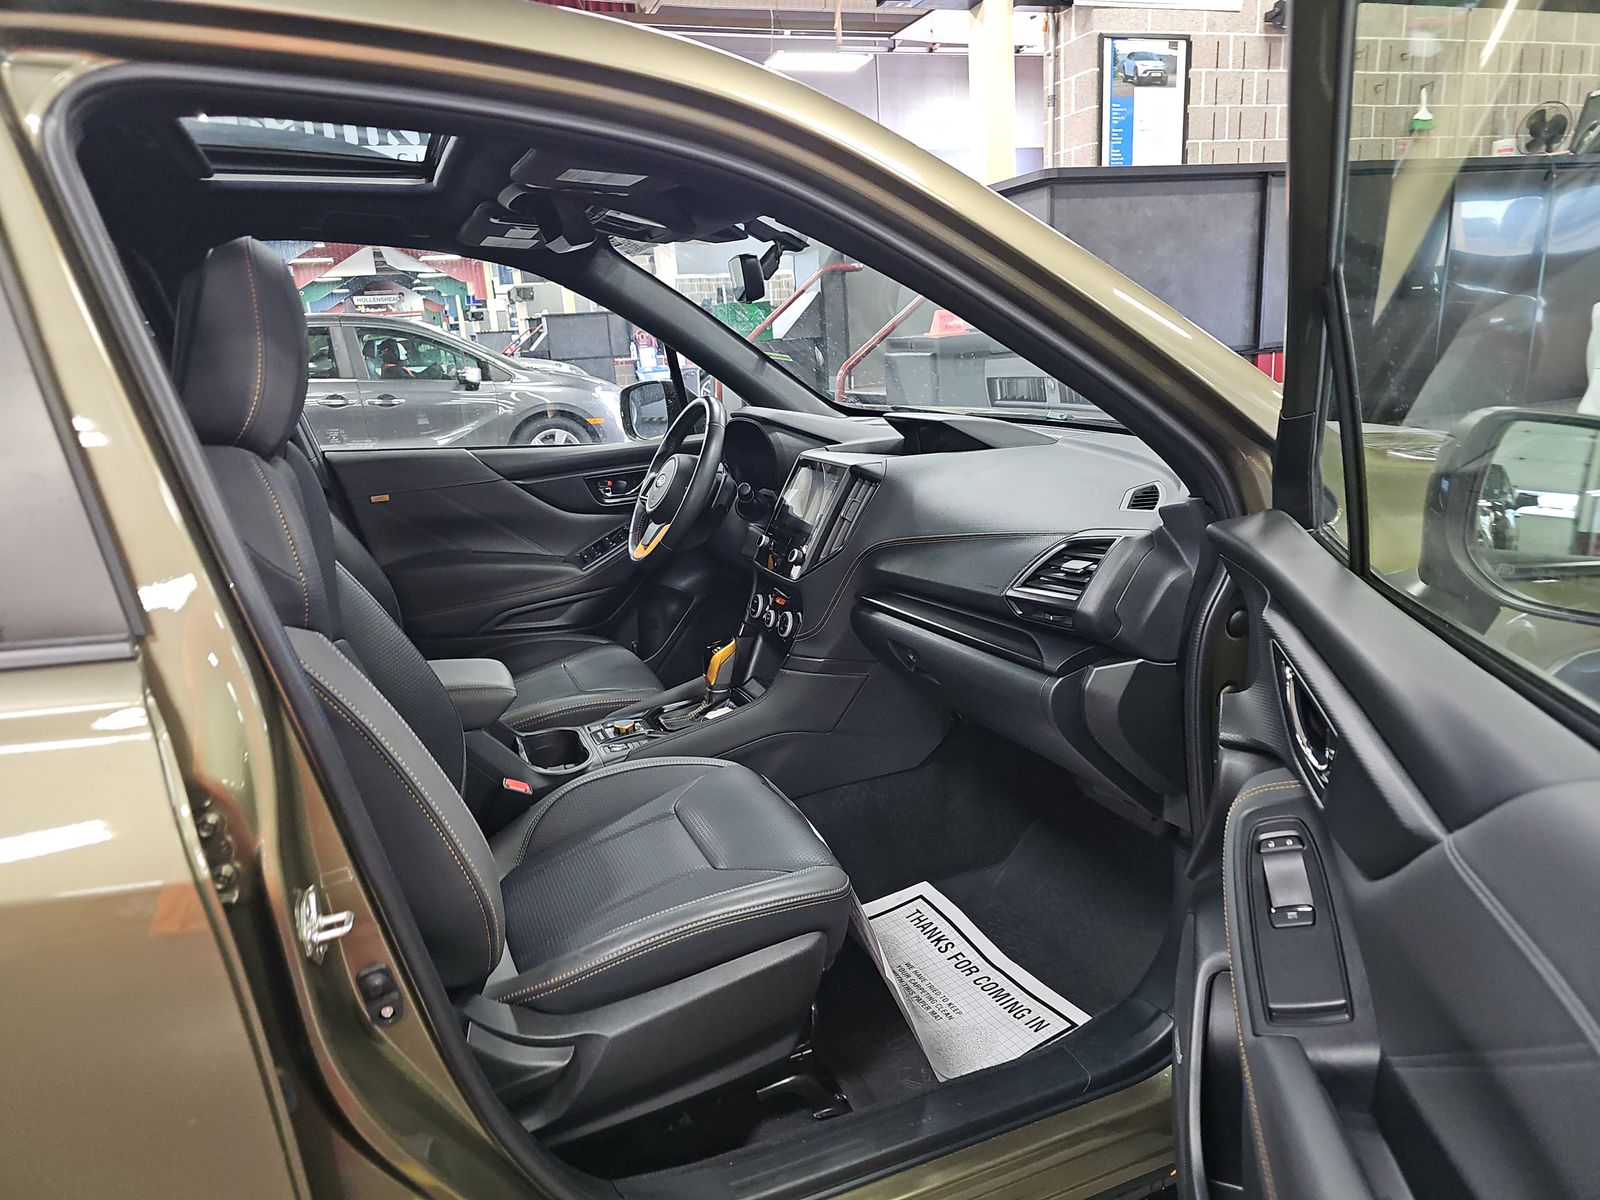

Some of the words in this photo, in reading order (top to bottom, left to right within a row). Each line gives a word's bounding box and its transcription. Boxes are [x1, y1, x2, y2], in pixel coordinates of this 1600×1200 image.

[896, 964, 911, 979] YOUR
[908, 978, 938, 1005] CARPETING
[935, 1003, 955, 1021] CLEAN
[905, 962, 916, 970] WE
[912, 970, 928, 983] HAVE
[925, 982, 942, 997] TRIED
[940, 995, 950, 1003] TO
[947, 1002, 963, 1015] KEEP
[906, 908, 955, 954] THANKS
[947, 952, 980, 977] FOR
[973, 976, 1032, 1021] COMING
[1024, 1016, 1051, 1033] IN
[901, 982, 916, 996] THIS
[912, 995, 932, 1011] PAPER
[929, 1010, 944, 1021] MAT
